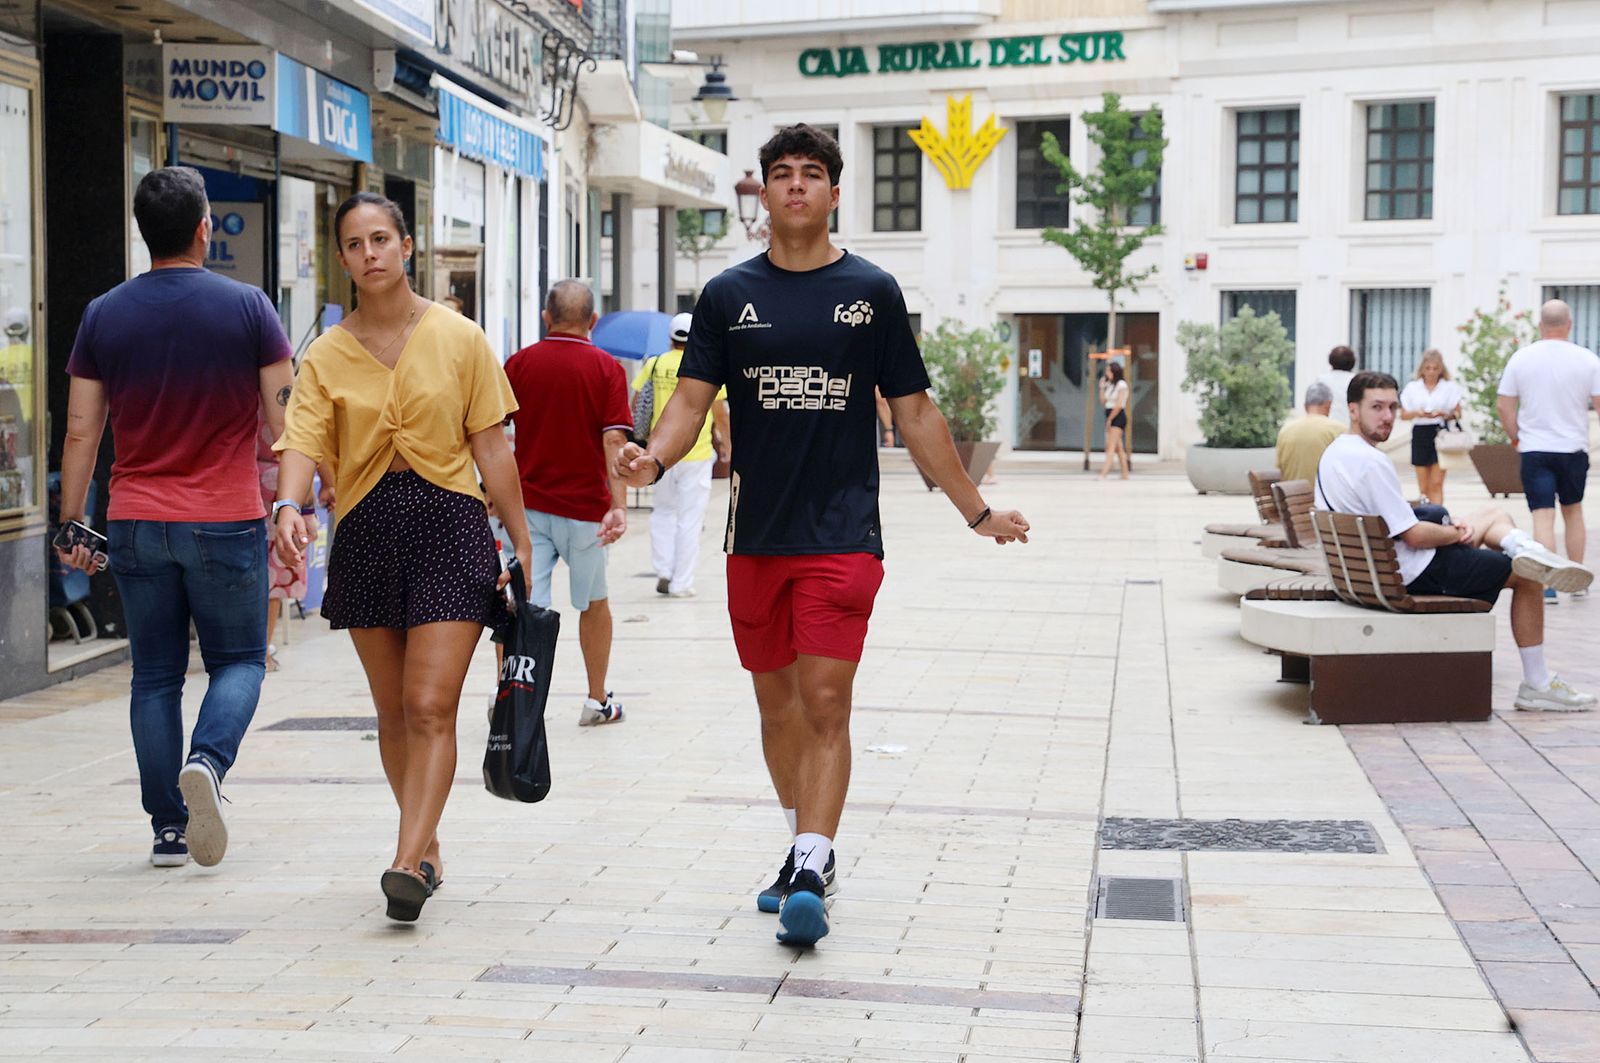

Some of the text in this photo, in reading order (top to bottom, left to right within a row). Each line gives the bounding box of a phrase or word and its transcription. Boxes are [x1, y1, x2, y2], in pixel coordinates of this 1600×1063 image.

[798, 31, 1126, 78] CAJA RURAL DEL SUR
[170, 59, 266, 79] MUNDO
[170, 79, 265, 101] MOVIL
[323, 99, 358, 151] DIGI
[743, 366, 823, 379] woman
[758, 372, 852, 400] padel
[760, 394, 848, 411] andaluz
